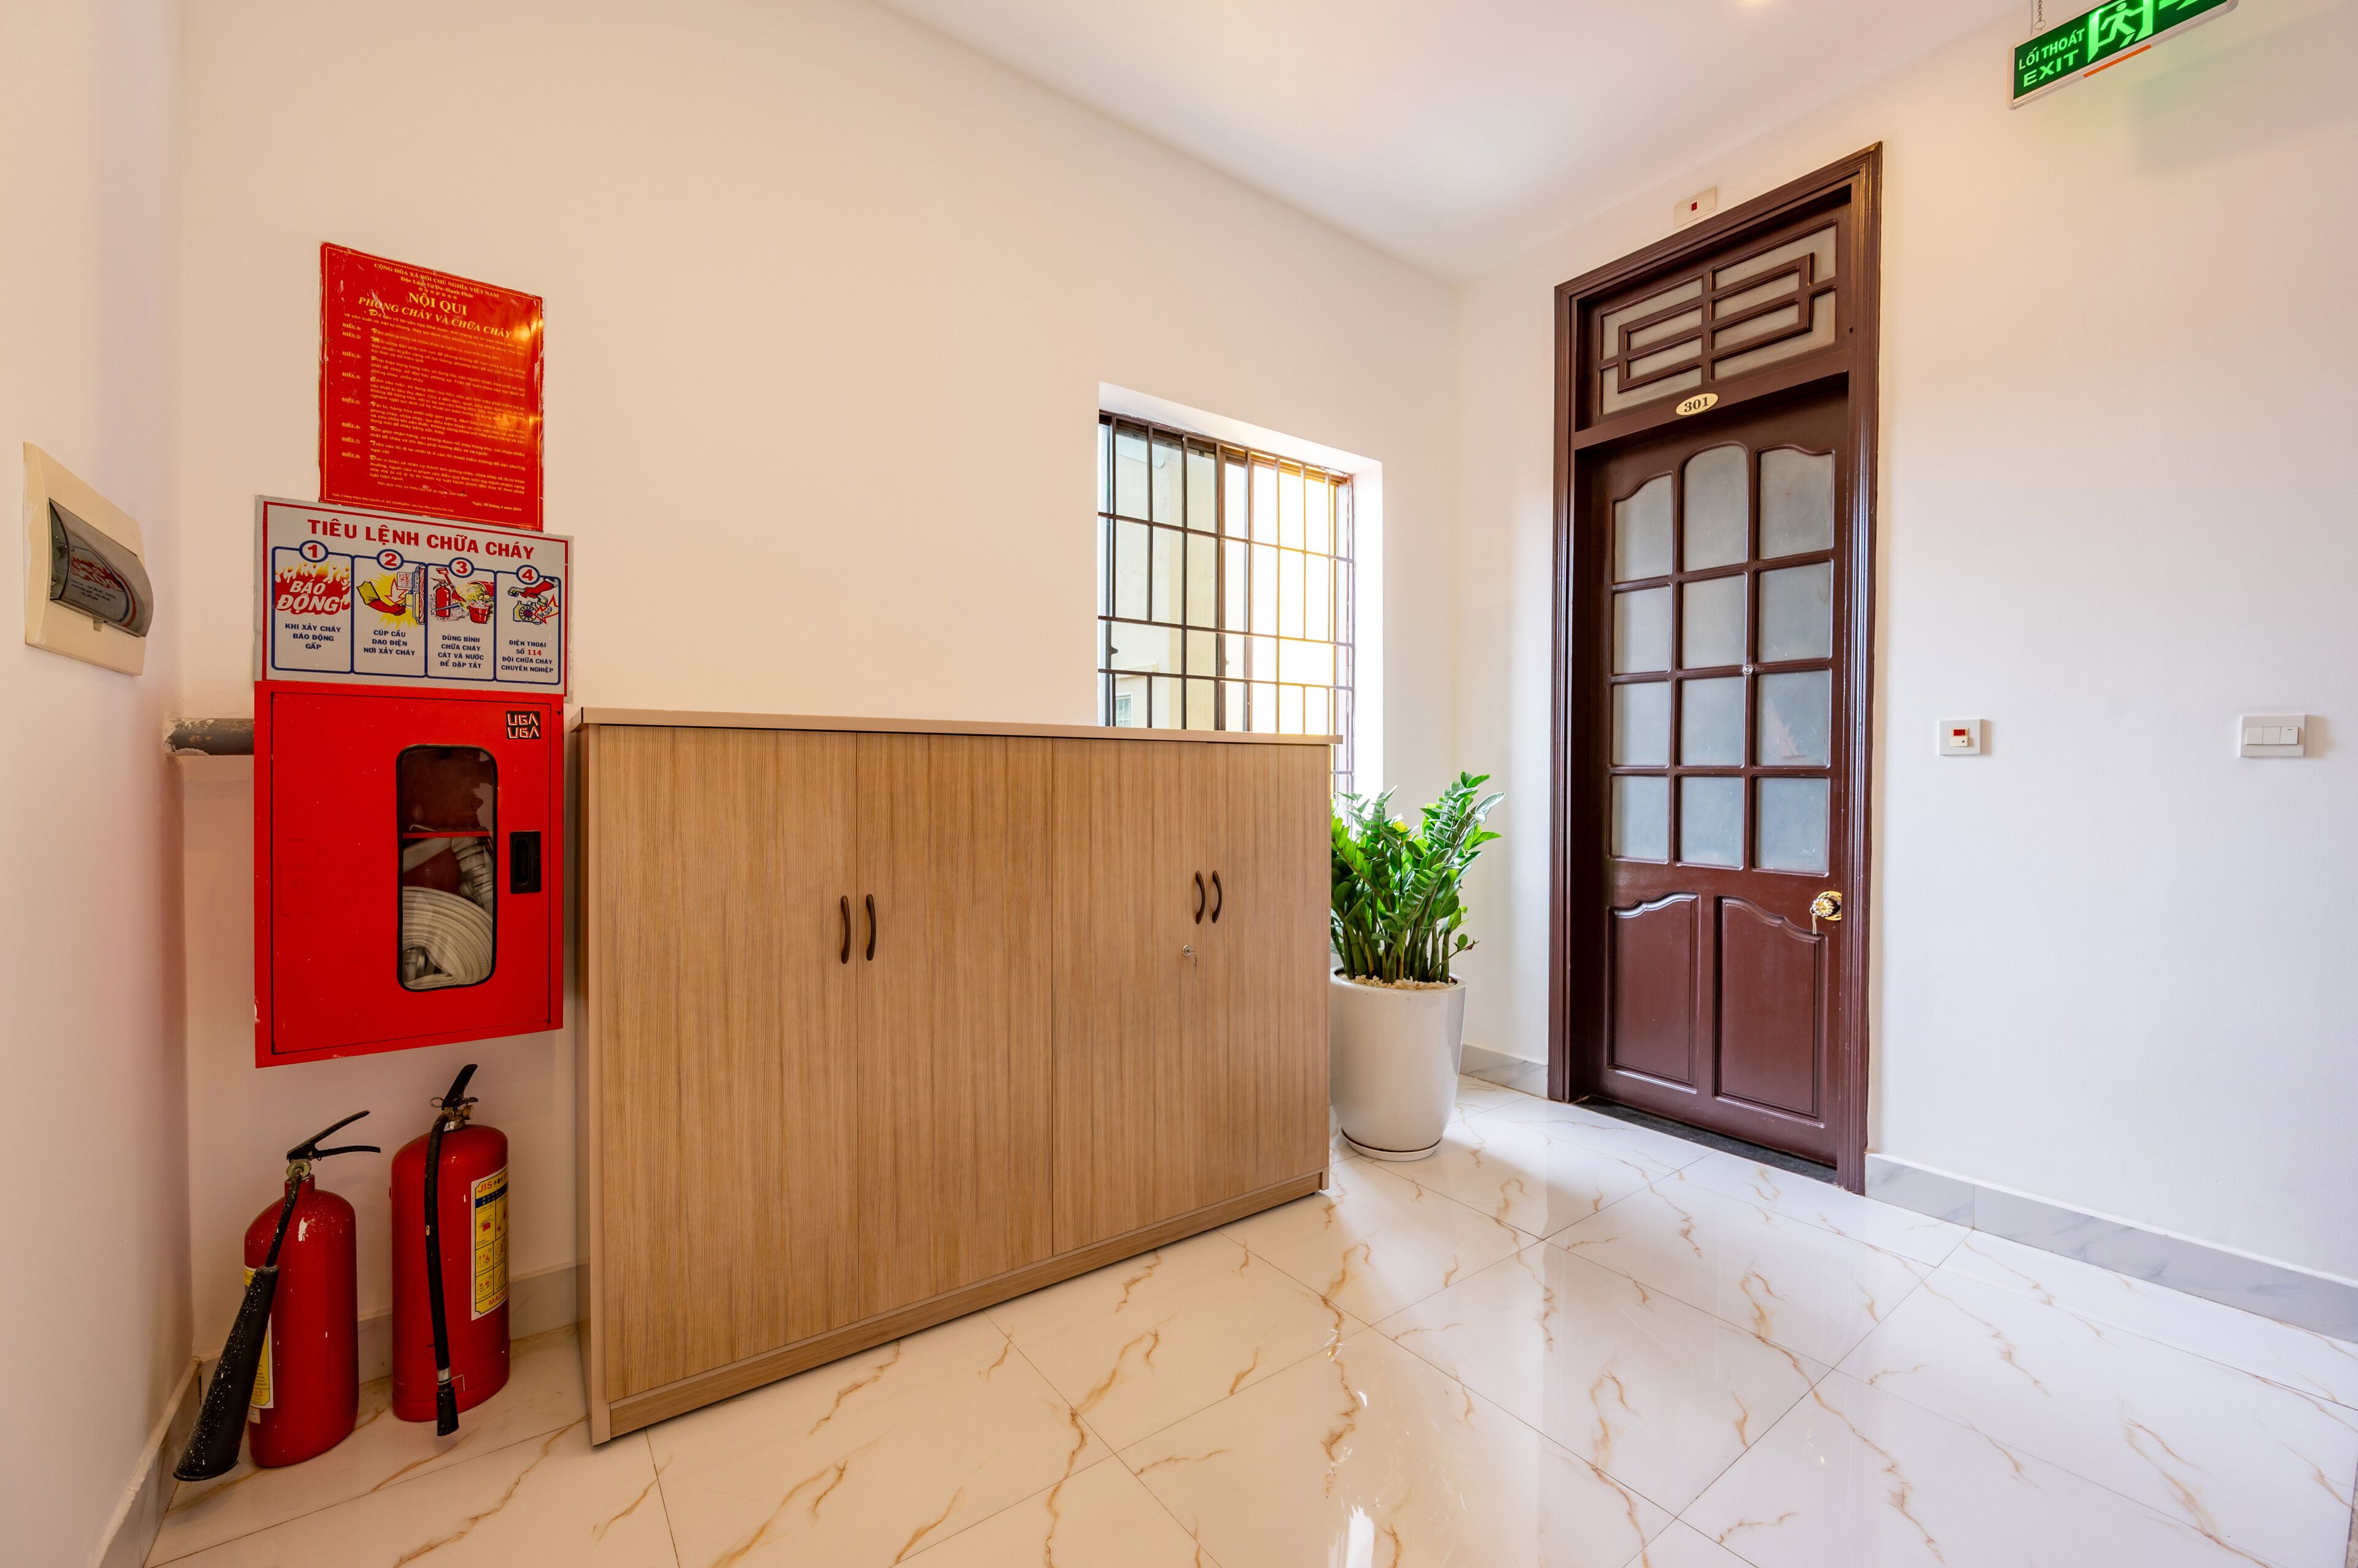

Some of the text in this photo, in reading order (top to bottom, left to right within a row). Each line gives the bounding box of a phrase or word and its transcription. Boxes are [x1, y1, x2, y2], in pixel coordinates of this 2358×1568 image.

[2018, 28, 2085, 70] LỐI THOÁT
[2023, 49, 2079, 87] EXIT
[408, 292, 467, 316] NỘI QUI
[359, 297, 512, 339] PHÒNG CHÁY VÀ CHỮA CHÁY
[1684, 396, 1709, 413] 301
[307, 518, 534, 559] TIÊU LỆNH CHỮA CHÁY
[308, 545, 317, 558] 1
[384, 553, 397, 567] 2
[456, 561, 467, 573] 3
[522, 569, 534, 581] 4
[290, 579, 325, 594] BÁO
[276, 593, 340, 613] ĐỘNG
[302, 623, 317, 631] XẢY
[312, 633, 334, 642] ĐỘNG
[507, 713, 539, 726] UGA
[508, 726, 540, 739] UGA
[478, 1181, 492, 1193] JIS
